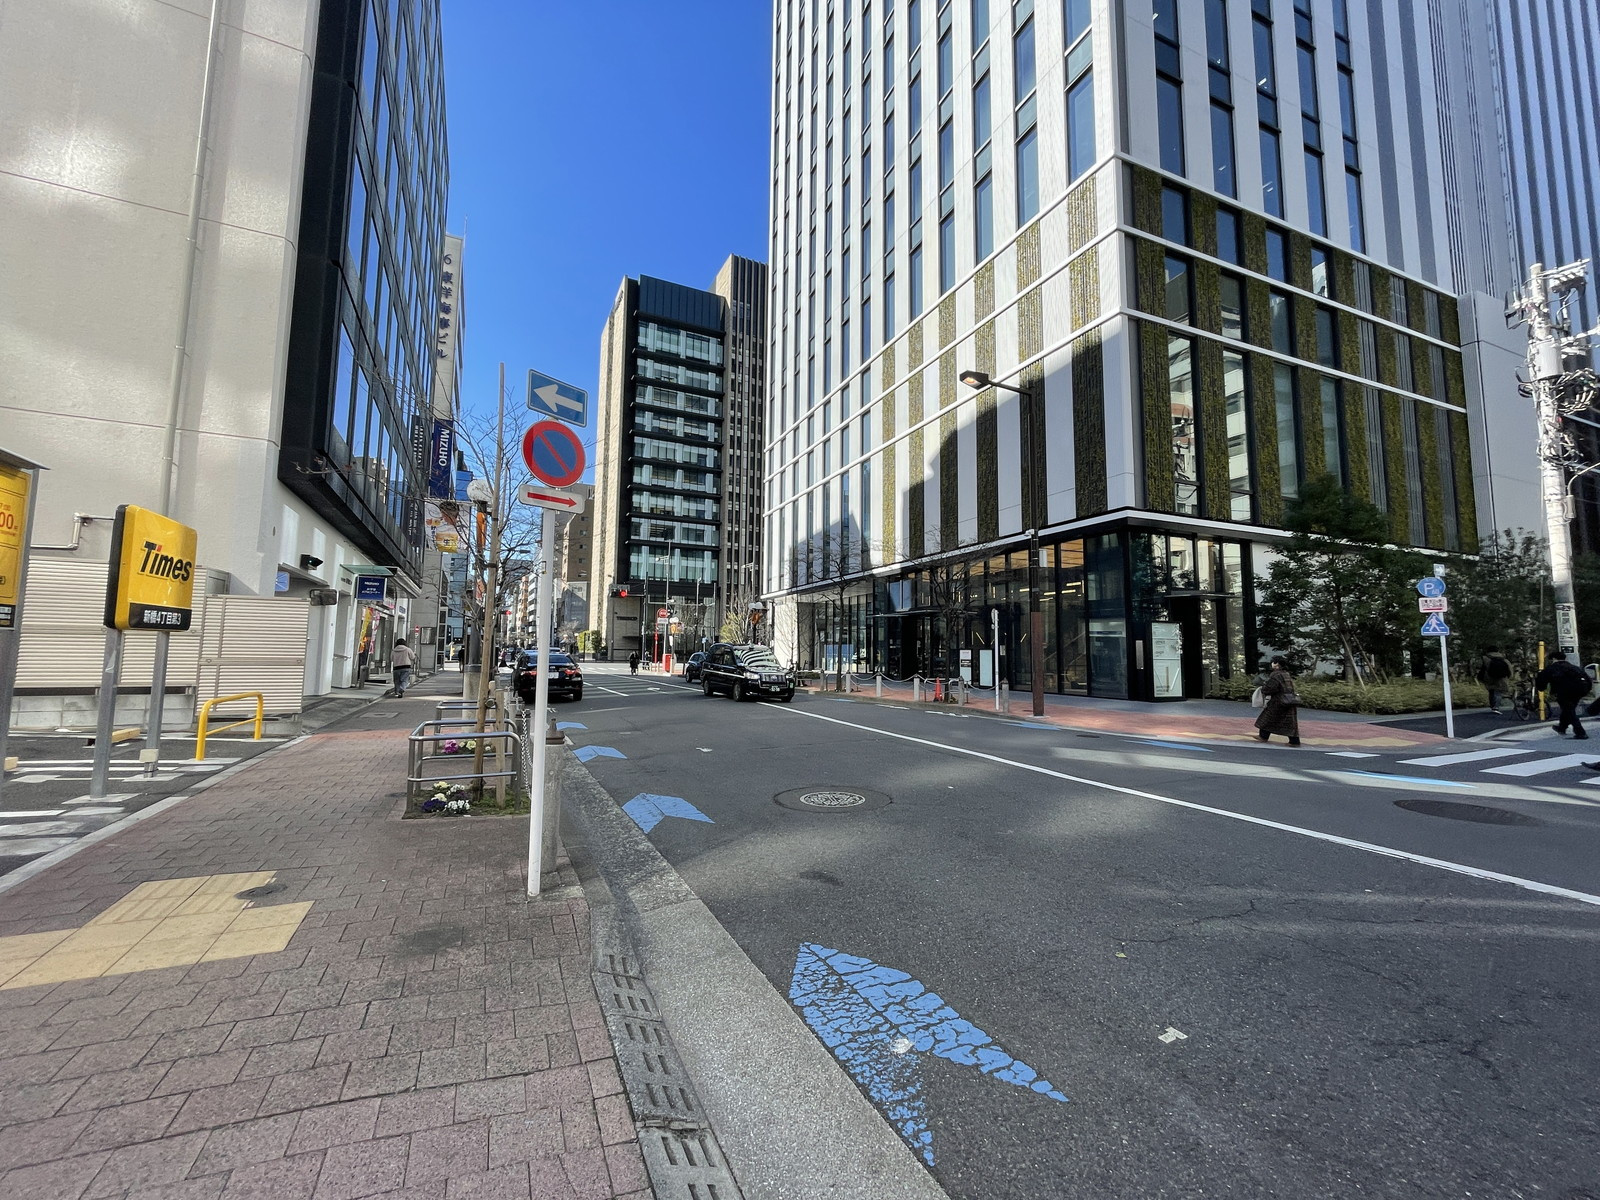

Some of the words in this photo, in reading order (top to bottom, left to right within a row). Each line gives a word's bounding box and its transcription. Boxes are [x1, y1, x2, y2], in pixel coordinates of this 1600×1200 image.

[438, 428, 450, 467] MIZUHO
[140, 541, 192, 582] Times
[1423, 582, 1434, 595] P
[143, 609, 182, 625] 新橋4丁目第3
